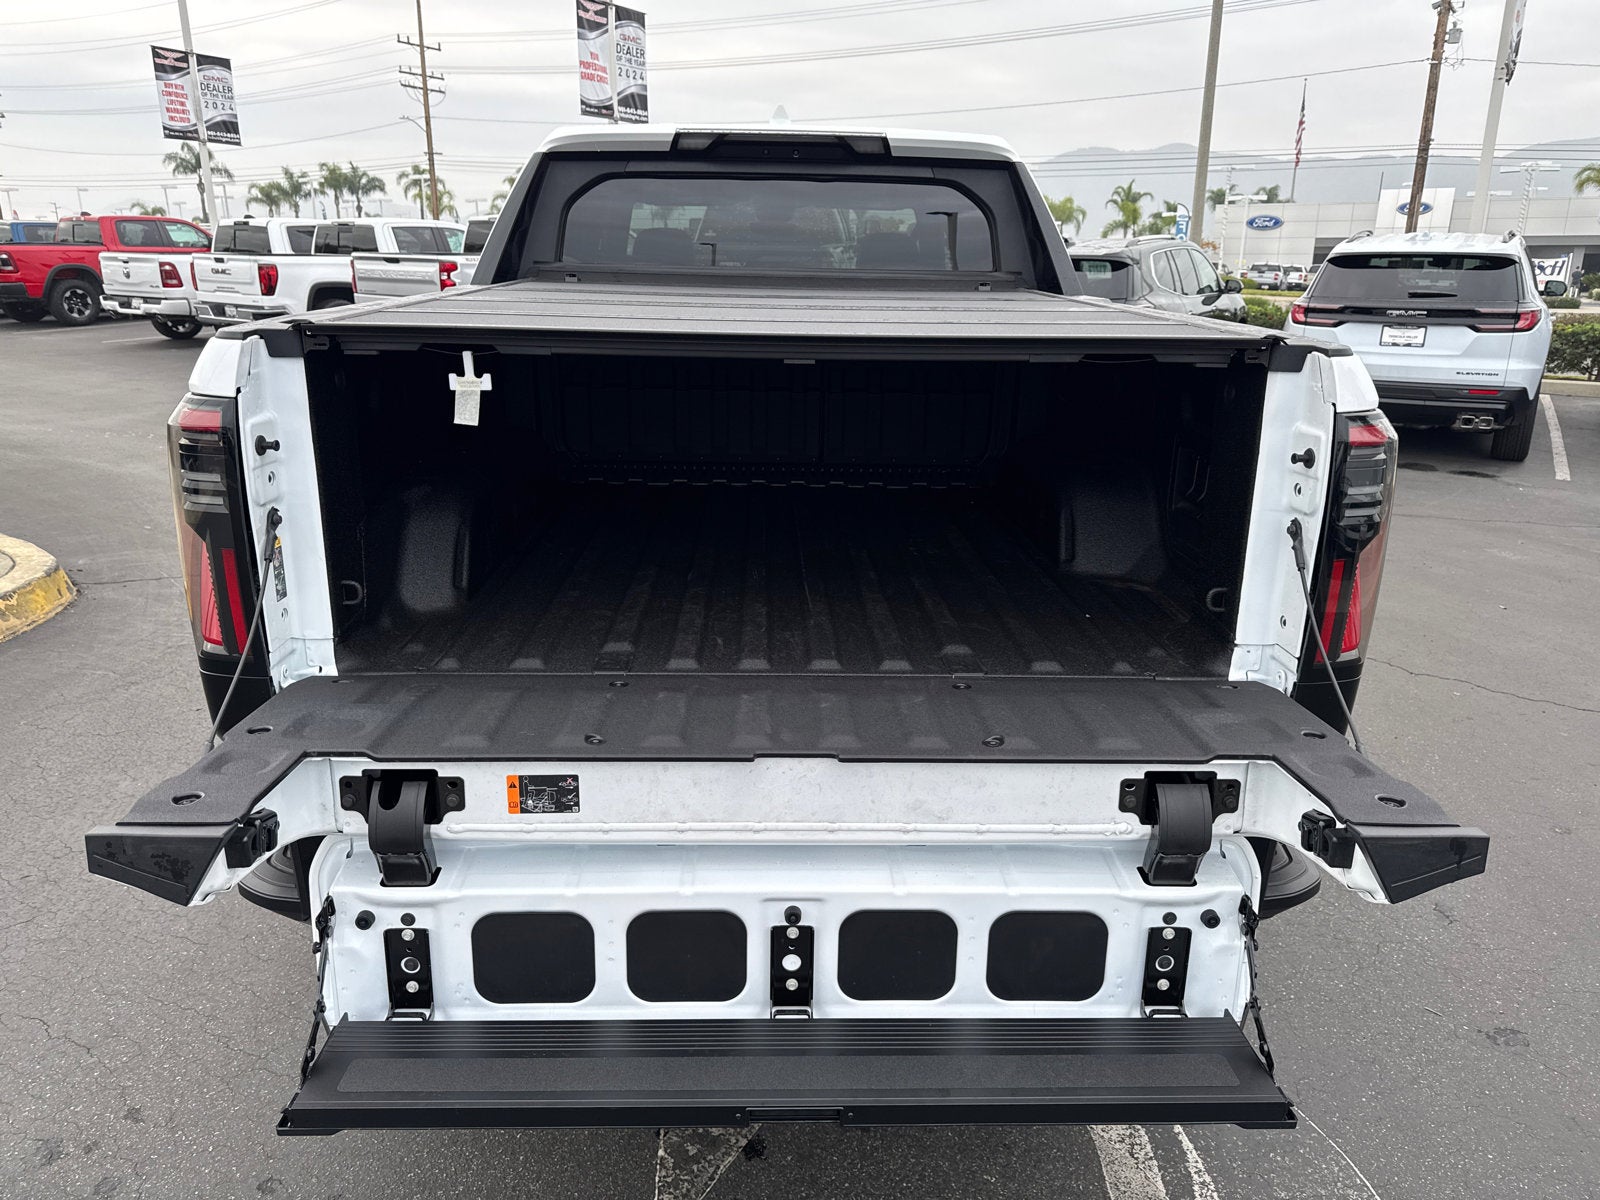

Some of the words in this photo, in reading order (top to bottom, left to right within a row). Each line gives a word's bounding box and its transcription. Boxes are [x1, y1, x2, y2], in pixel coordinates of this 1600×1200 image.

[620, 34, 641, 44] GMC
[616, 43, 645, 60] DEALER
[624, 57, 633, 65] THE
[618, 67, 644, 80] 2024
[203, 75, 228, 83] GMC
[200, 82, 233, 94] DEALER
[162, 90, 188, 100] CONFIDENCE
[204, 101, 233, 111] 2024
[1252, 217, 1275, 228] Ford
[211, 267, 232, 276] GMC
[357, 269, 432, 280] CHEVROLET
[1386, 310, 1427, 318] GMC
